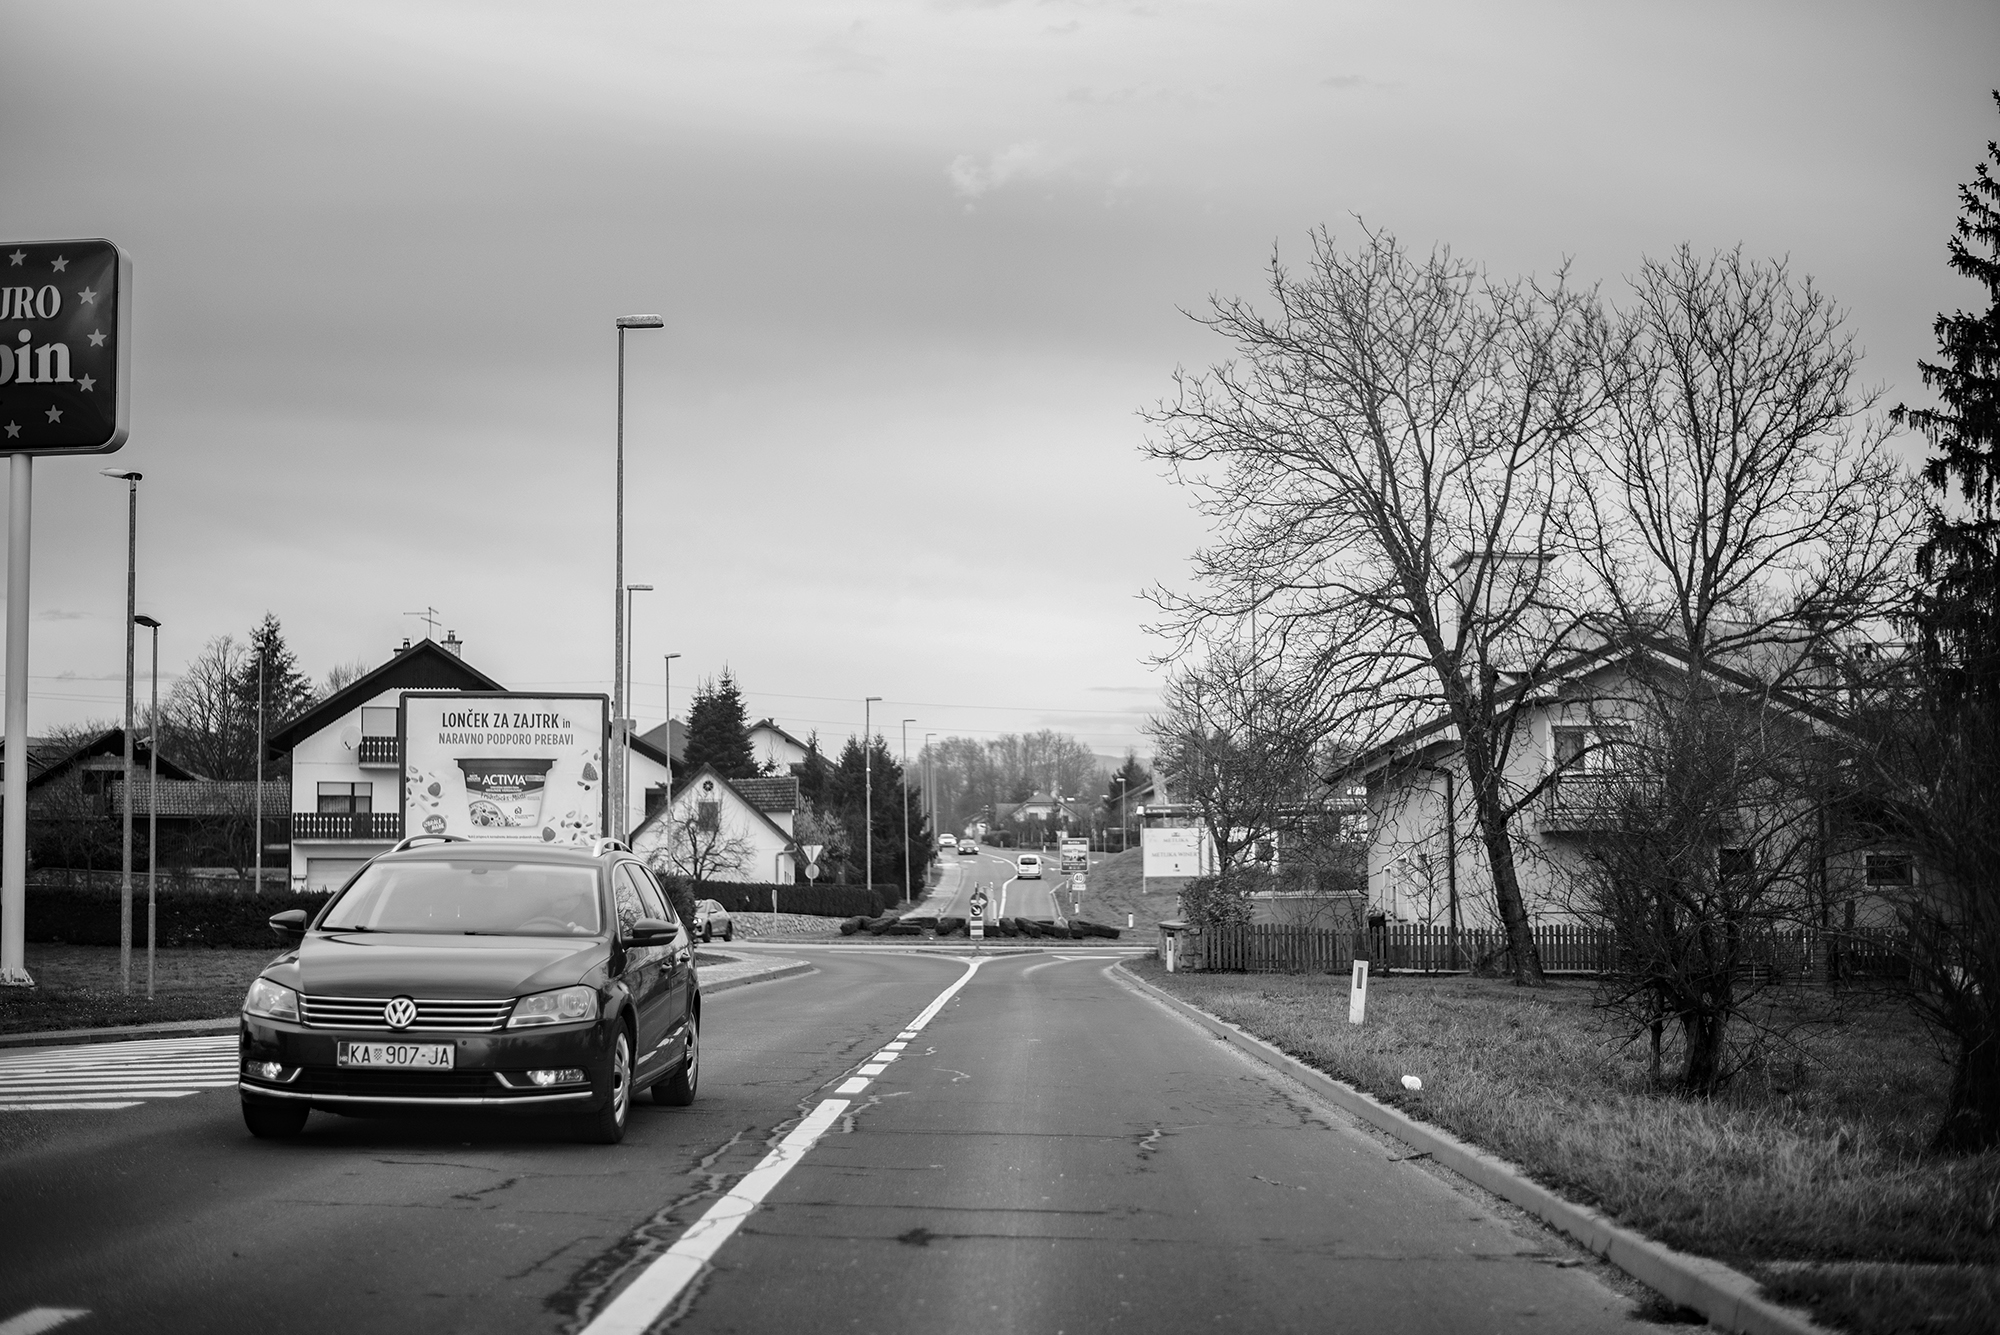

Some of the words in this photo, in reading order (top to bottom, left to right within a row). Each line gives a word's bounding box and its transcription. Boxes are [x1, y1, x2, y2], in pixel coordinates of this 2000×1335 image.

[442, 708, 489, 728] LONČEK
[493, 713, 509, 728] ZA
[513, 713, 559, 729] ZAJTRK
[562, 718, 571, 729] in
[438, 732, 484, 745] NARAVNO
[487, 733, 532, 745] PODPORO
[534, 733, 574, 745] PREBAVI
[482, 774, 526, 785] ACTIVIA
[350, 1045, 371, 1063] KA
